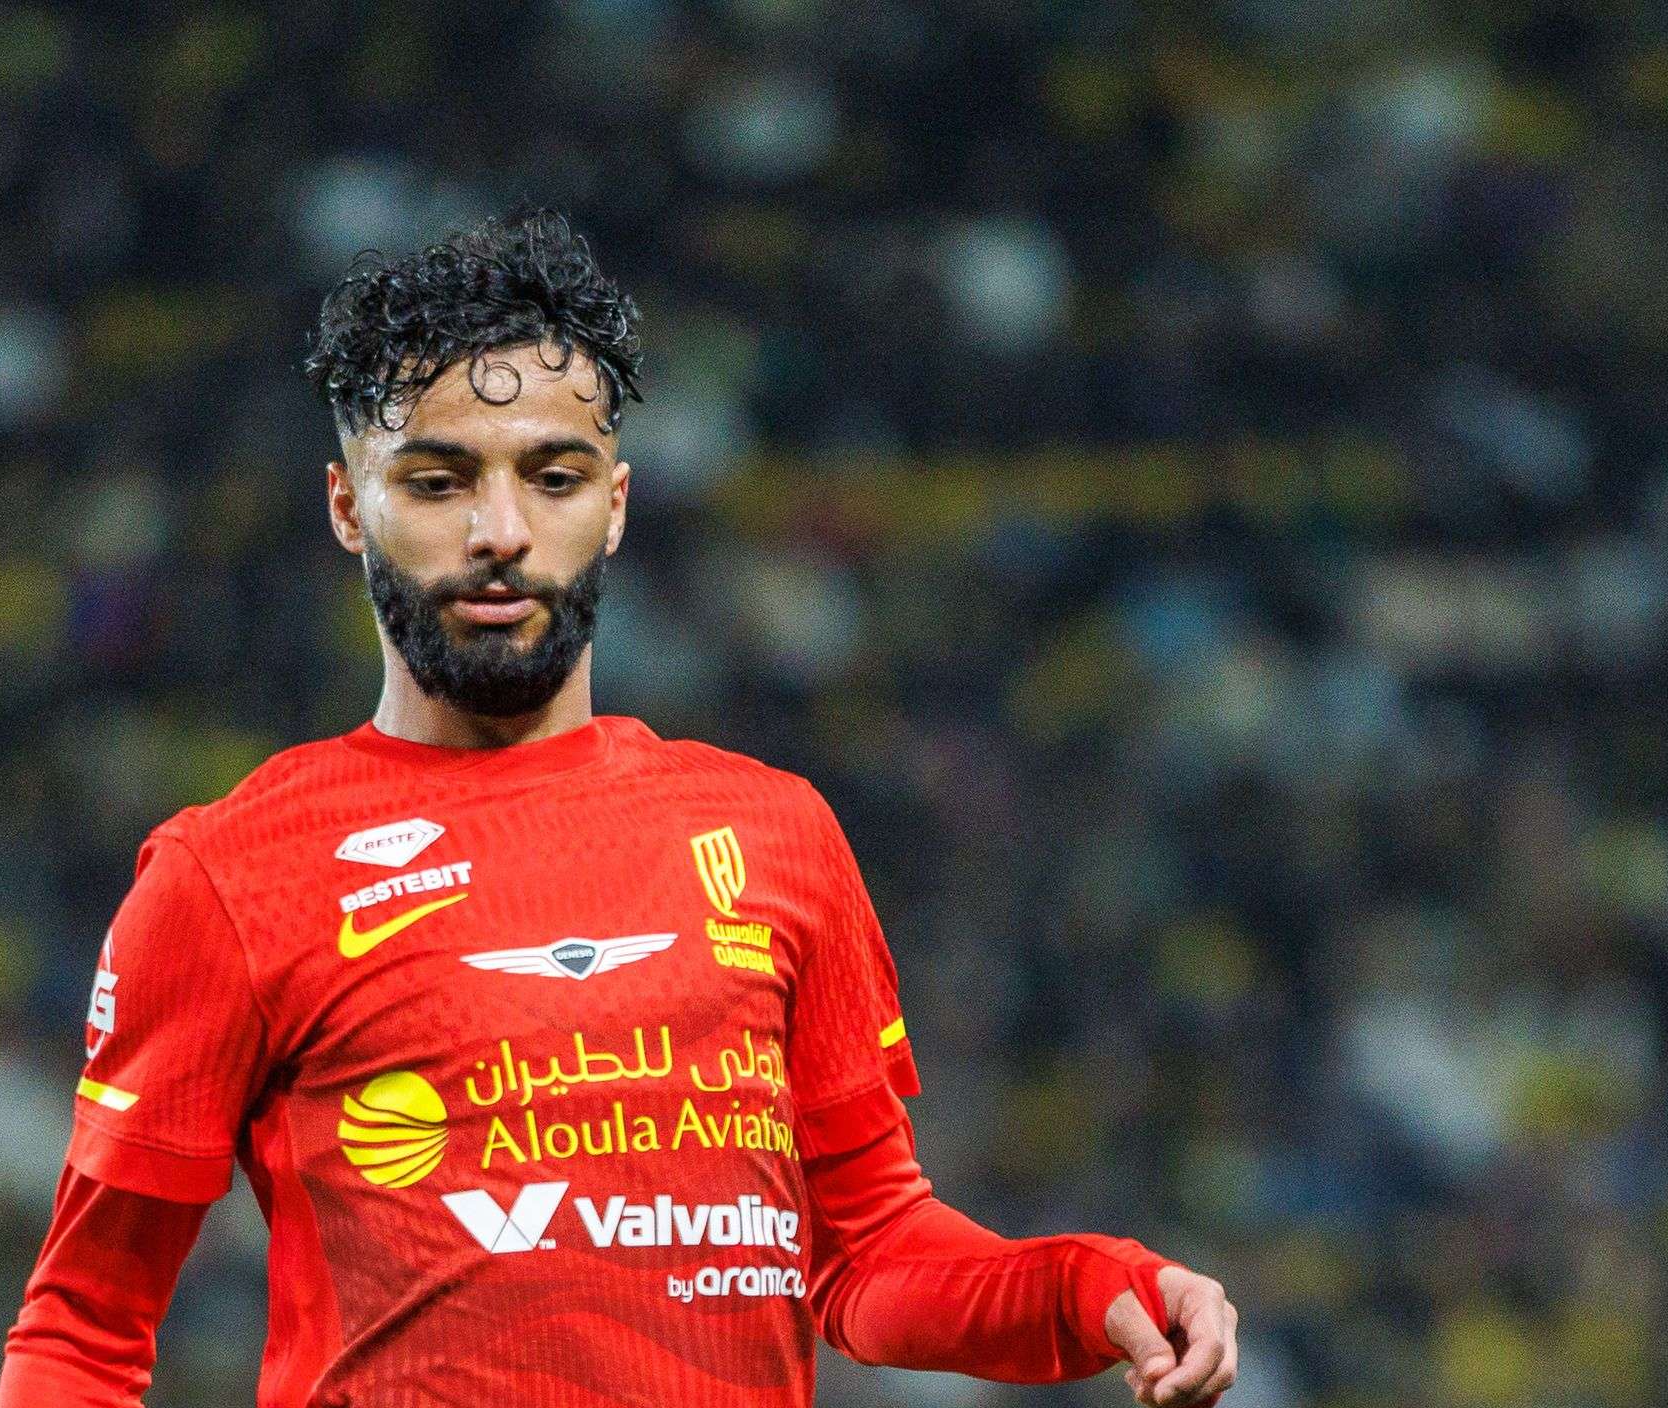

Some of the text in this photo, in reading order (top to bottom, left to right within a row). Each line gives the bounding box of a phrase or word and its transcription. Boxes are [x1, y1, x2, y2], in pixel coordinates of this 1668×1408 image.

[339, 860, 472, 913] BESTEBIT
[465, 1025, 673, 1107] للطيران
[481, 1101, 661, 1170] Aloula
[573, 1194, 802, 1257] Valvoline
[667, 1275, 694, 1303] by
